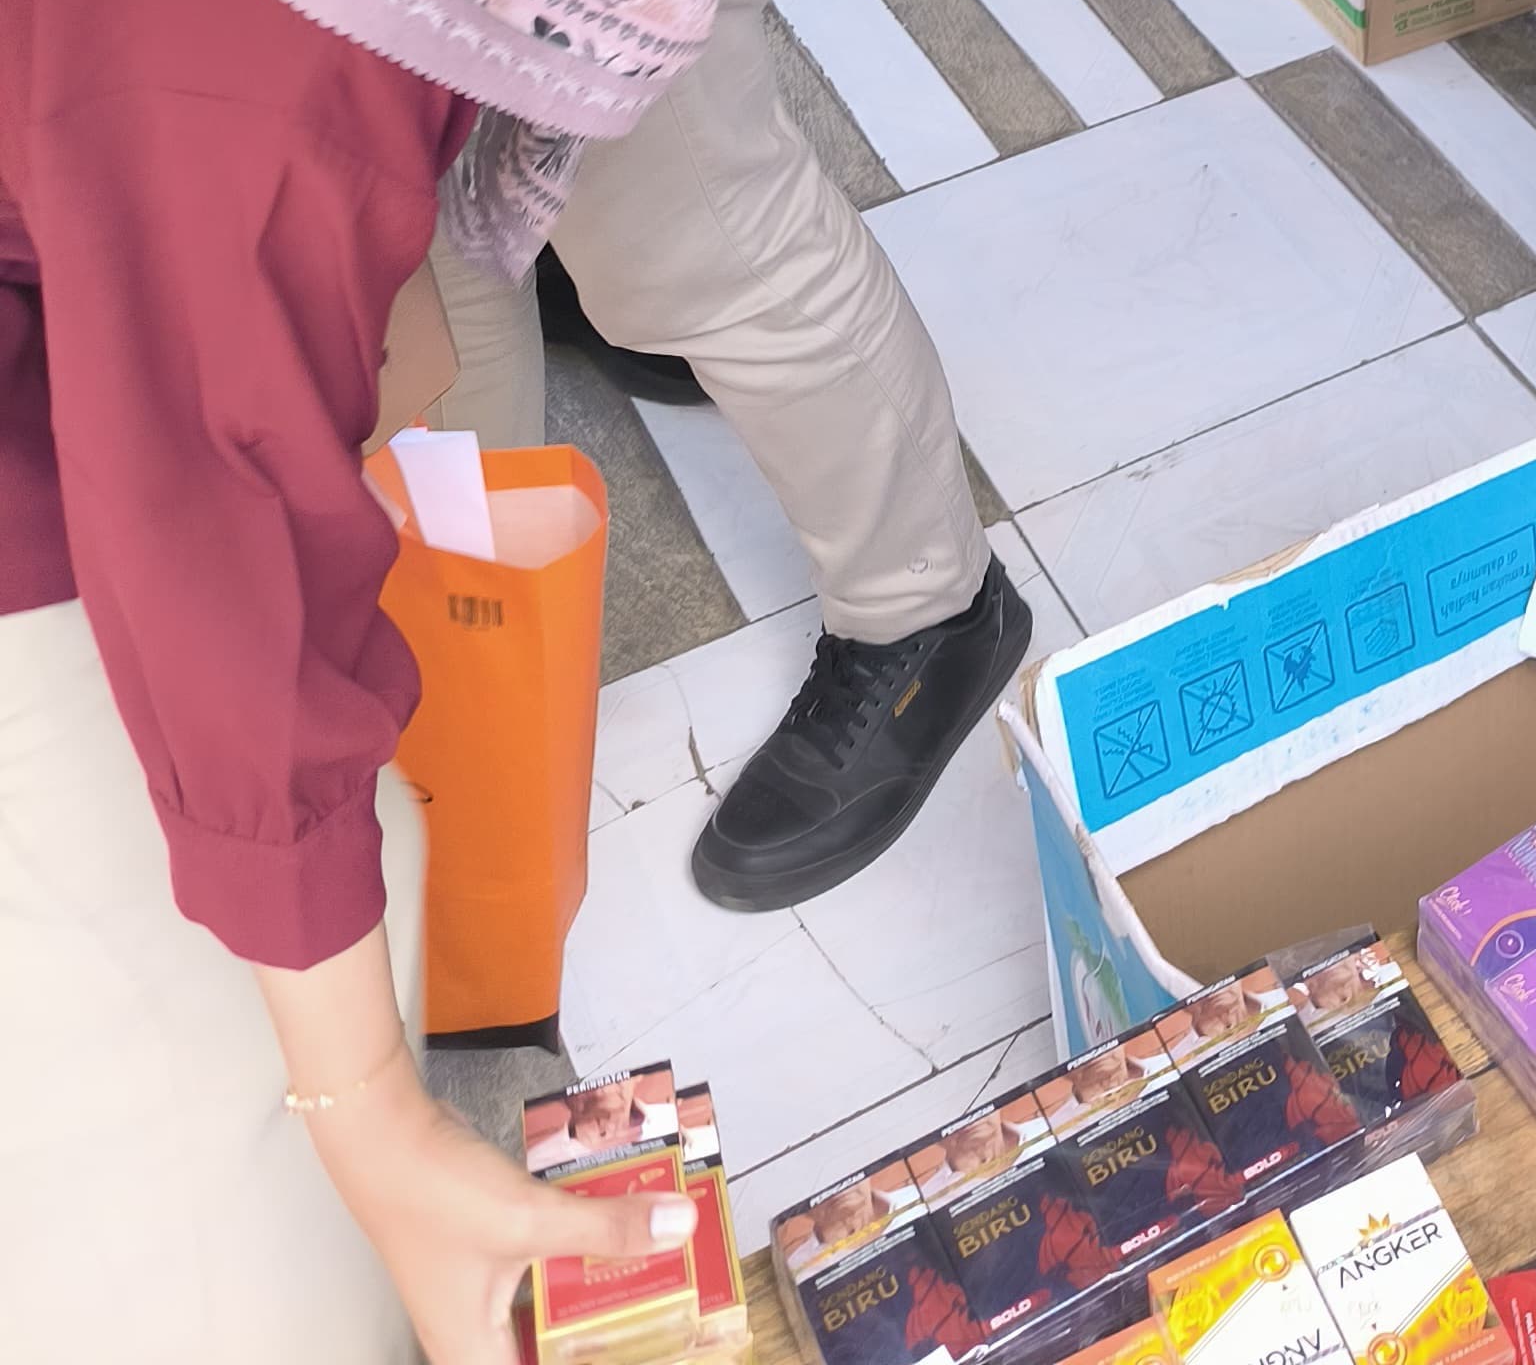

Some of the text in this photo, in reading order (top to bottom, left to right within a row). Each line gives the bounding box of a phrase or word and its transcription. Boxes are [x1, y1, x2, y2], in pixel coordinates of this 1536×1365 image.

[1207, 1064, 1278, 1115] BIRU
[1086, 1133, 1158, 1187] BIRU
[957, 1203, 1032, 1258] BIRU
[1337, 1221, 1444, 1290] ANGKER
[822, 1273, 900, 1334] BIRU
